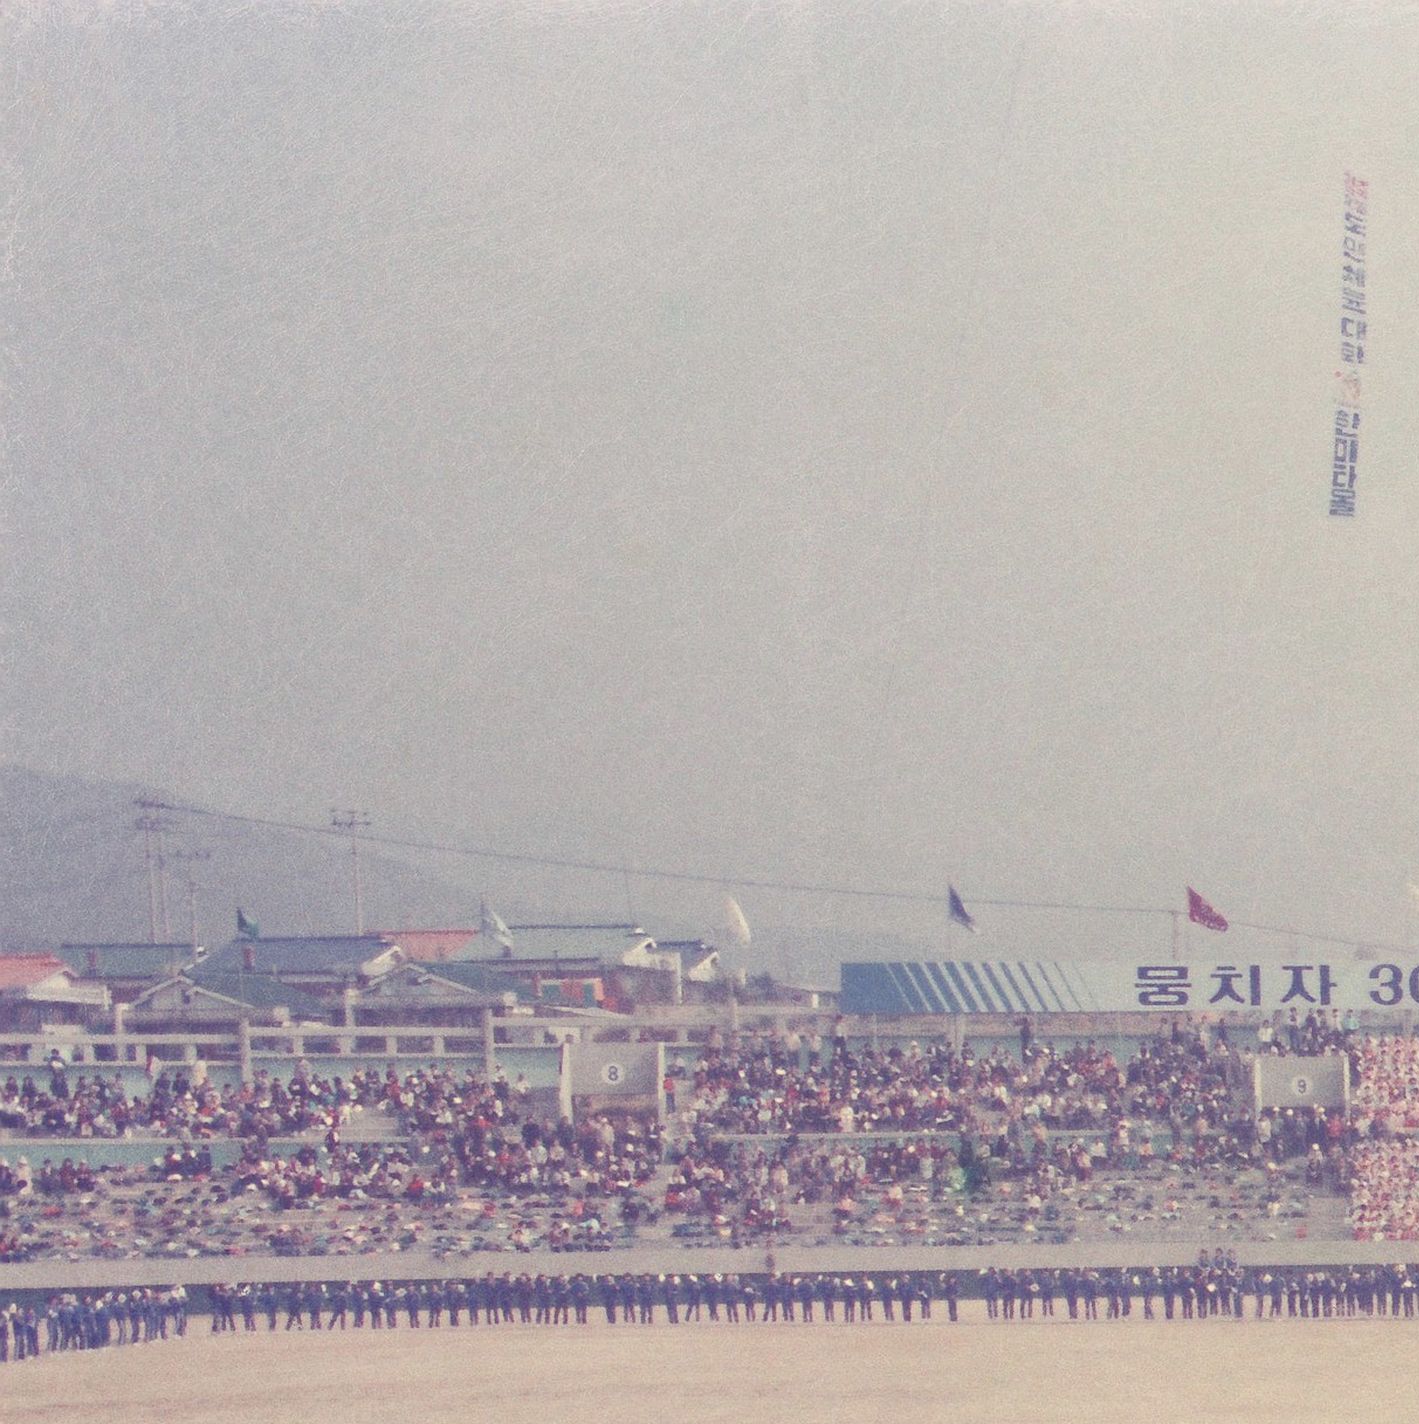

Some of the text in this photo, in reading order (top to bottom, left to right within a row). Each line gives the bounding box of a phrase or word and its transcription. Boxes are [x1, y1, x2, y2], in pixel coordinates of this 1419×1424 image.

[1134, 965, 1338, 1006] 뭉치자
[608, 1065, 618, 1081] 8
[1298, 1079, 1306, 1094] 9
